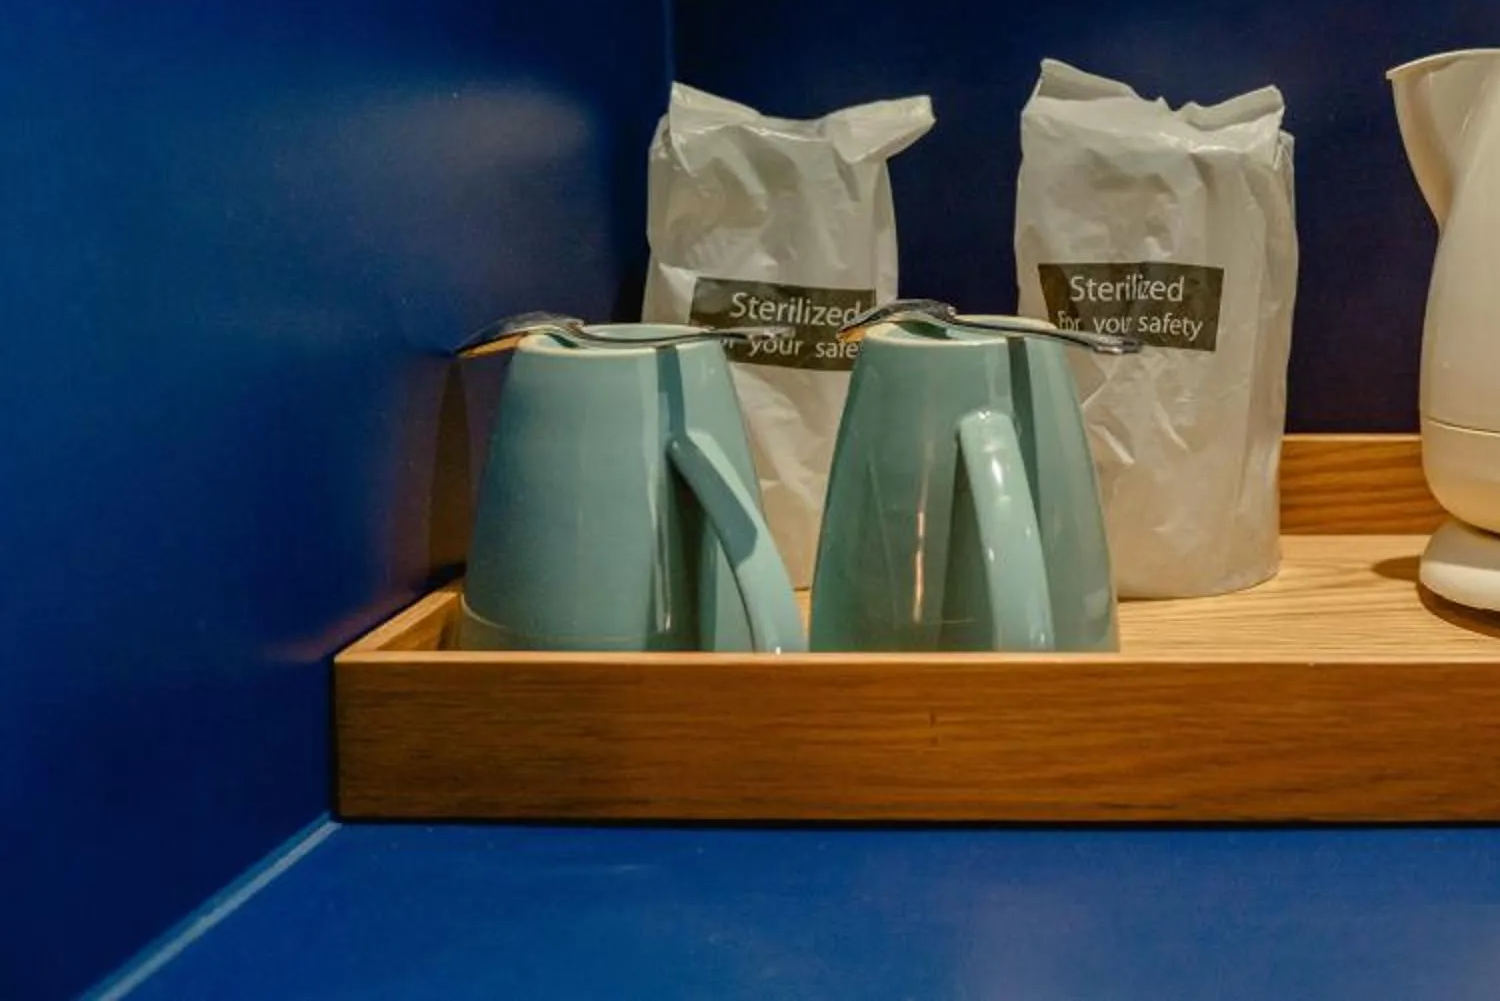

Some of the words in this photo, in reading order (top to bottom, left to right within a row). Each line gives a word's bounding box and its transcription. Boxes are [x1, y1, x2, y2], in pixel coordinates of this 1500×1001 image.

[1070, 273, 1185, 302] Sterilized
[729, 292, 862, 326] Sterilized
[1137, 312, 1204, 341] safety
[748, 334, 803, 356] your
[815, 338, 859, 358] safe
